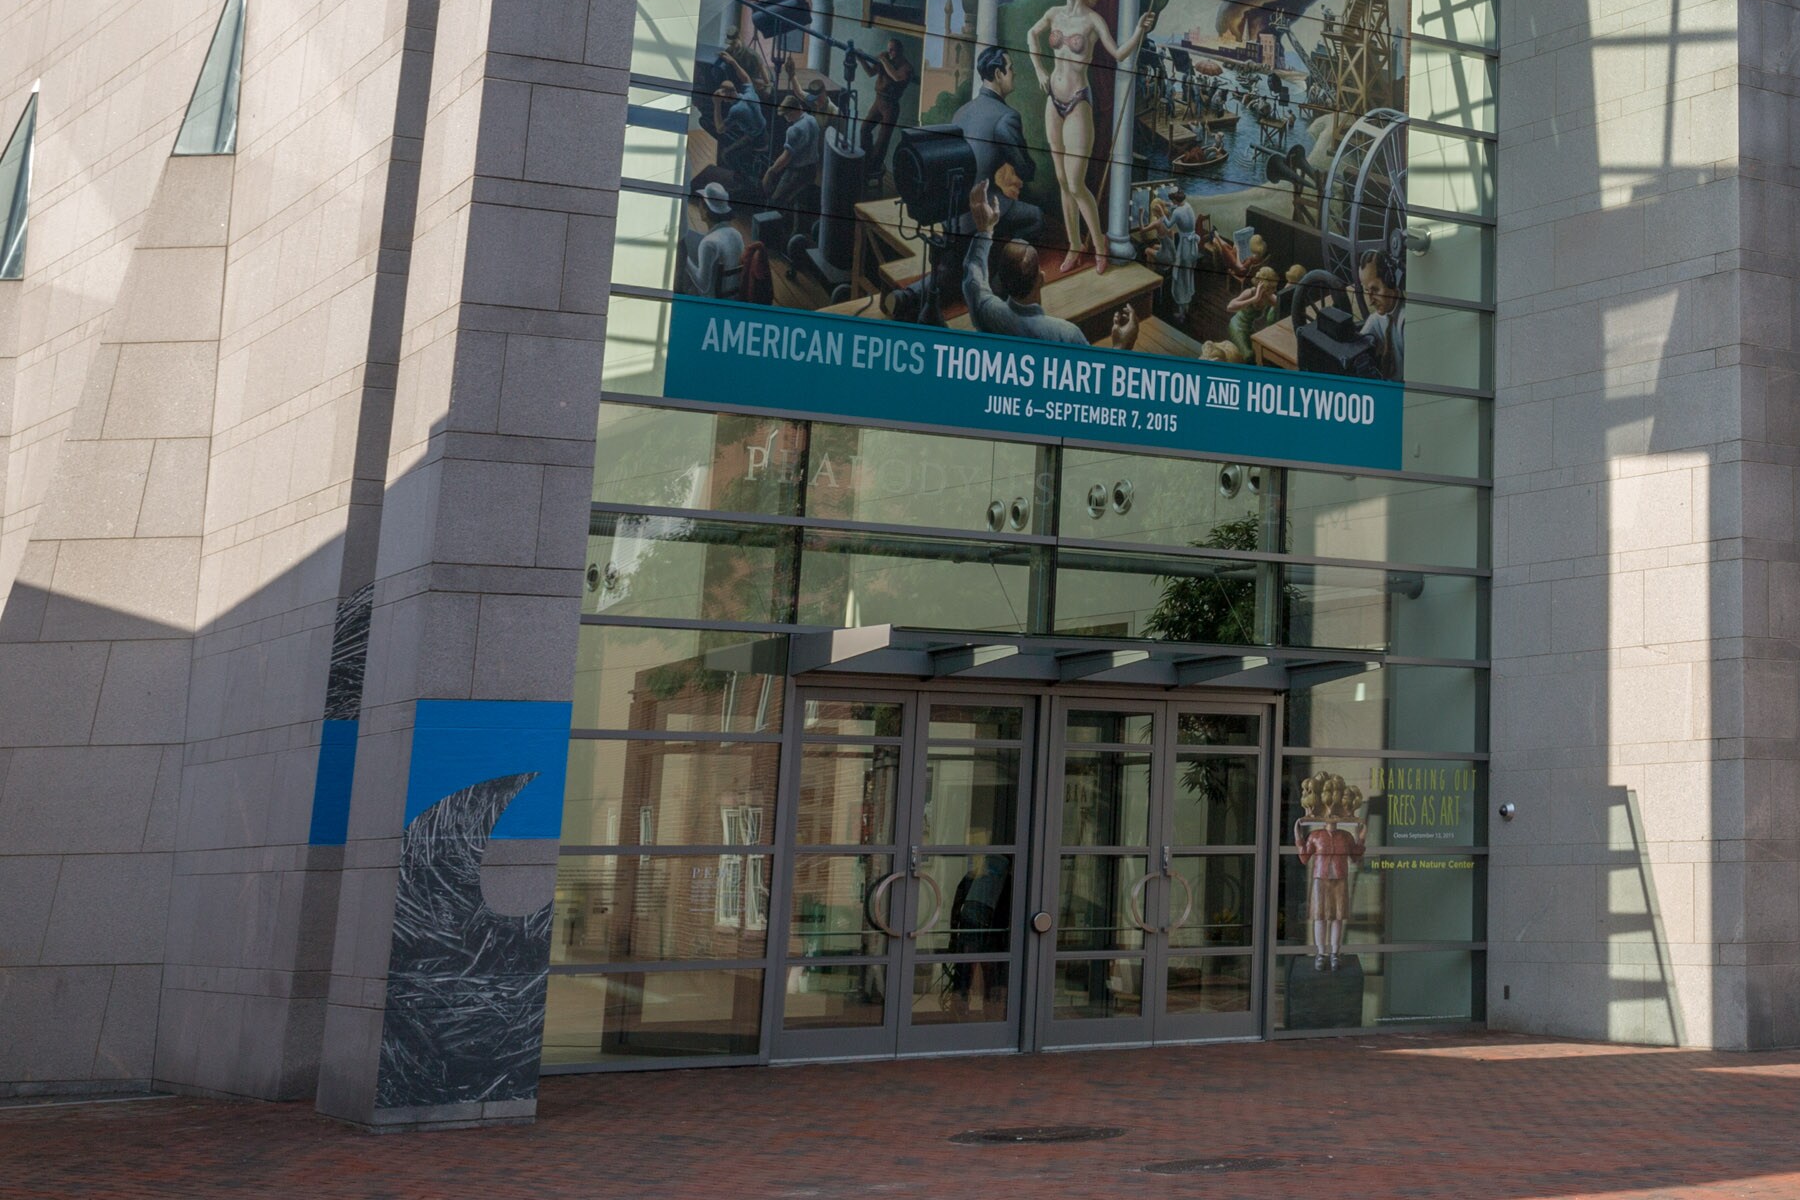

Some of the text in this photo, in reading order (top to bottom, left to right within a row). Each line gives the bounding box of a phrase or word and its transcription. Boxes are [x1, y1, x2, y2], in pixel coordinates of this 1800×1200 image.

[701, 317, 1376, 425] AMERICAN EPICS THOMAS HART BENTON AND HOLLYWOOD
[984, 395, 1021, 416] JUNE
[1131, 411, 1142, 430] 7,
[1146, 412, 1178, 432] 2015
[1369, 767, 1477, 792] BRANCHING OUT
[1388, 794, 1460, 826] TREES AS ART
[1371, 860, 1475, 869] In the Art & Nature Center
